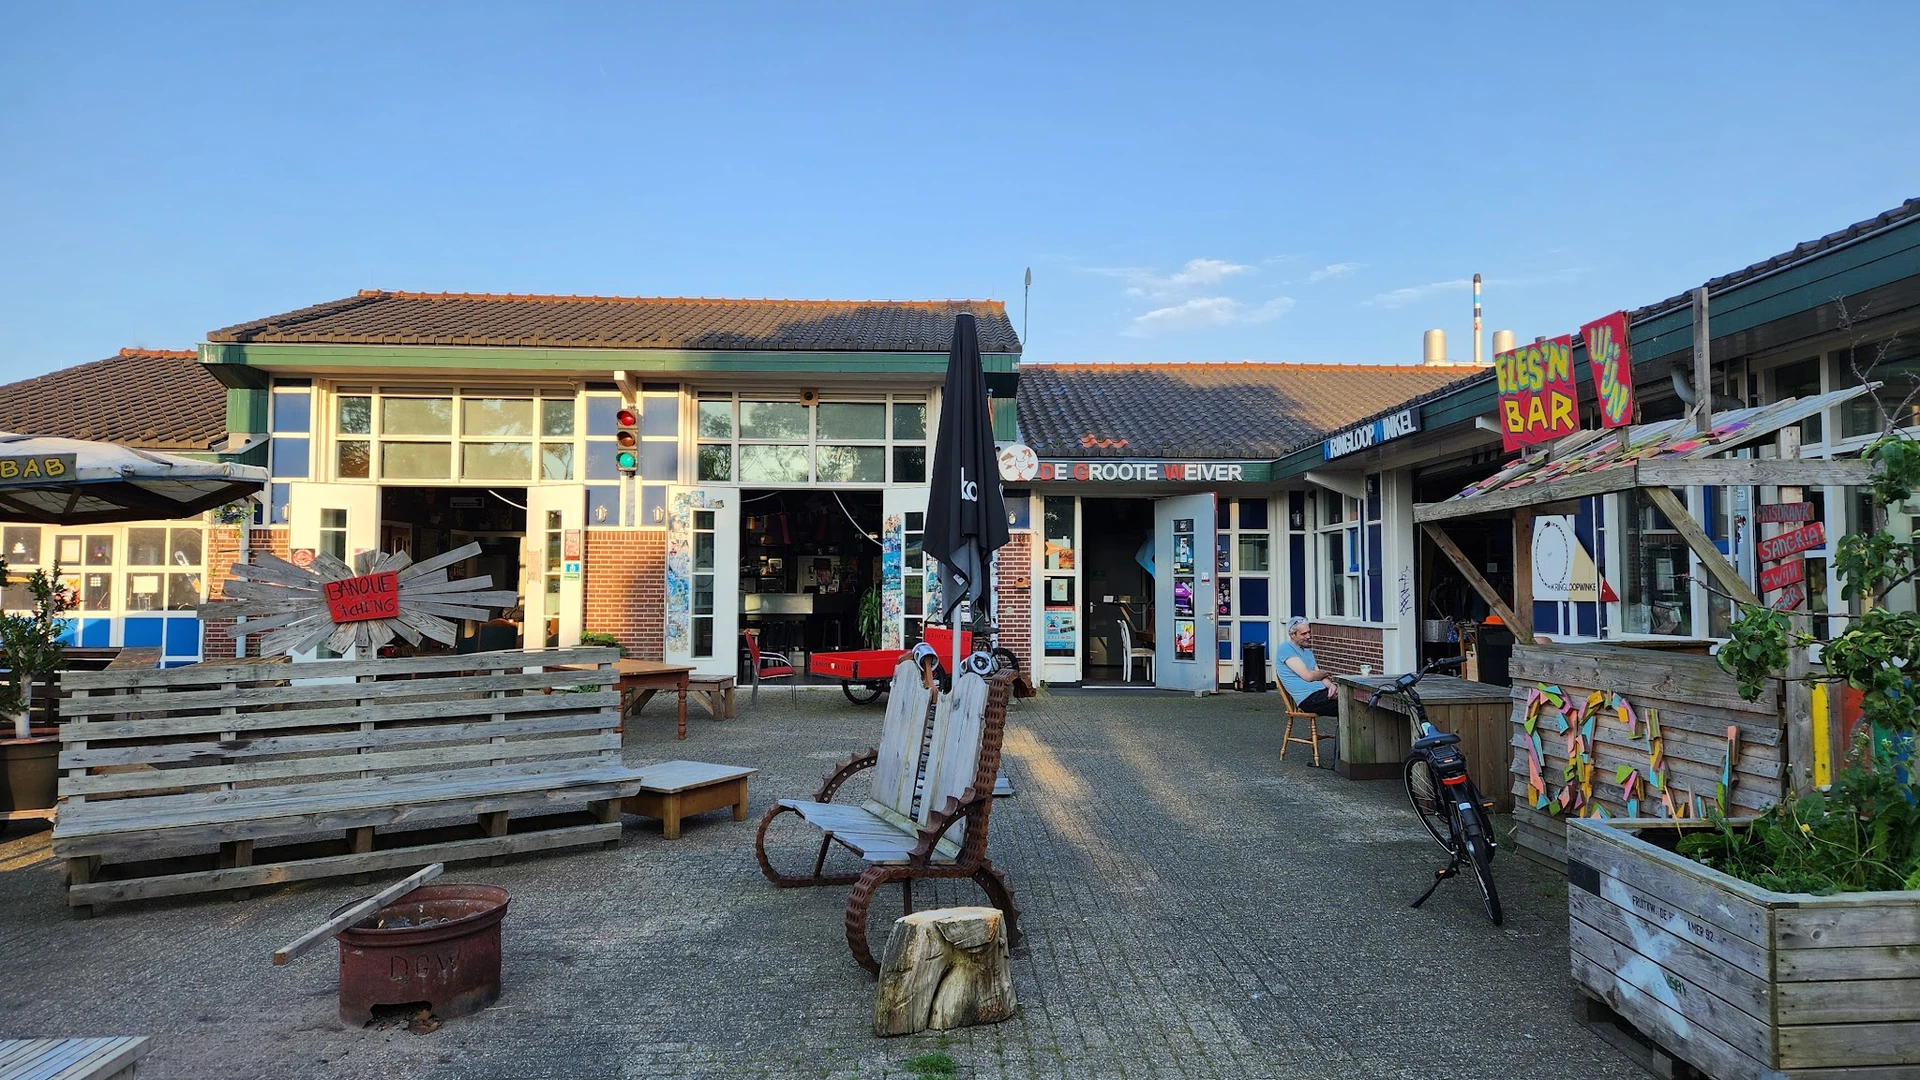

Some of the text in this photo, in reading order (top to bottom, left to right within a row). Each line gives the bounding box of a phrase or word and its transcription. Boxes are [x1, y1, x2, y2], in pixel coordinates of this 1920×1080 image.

[1495, 341, 1569, 396] FLES'N
[1504, 390, 1575, 433] BAR
[1323, 410, 1417, 460] KRINGLOOPWINKEL
[0, 457, 66, 479] BAB
[1040, 463, 1243, 482] DE GROOTE WEIVER
